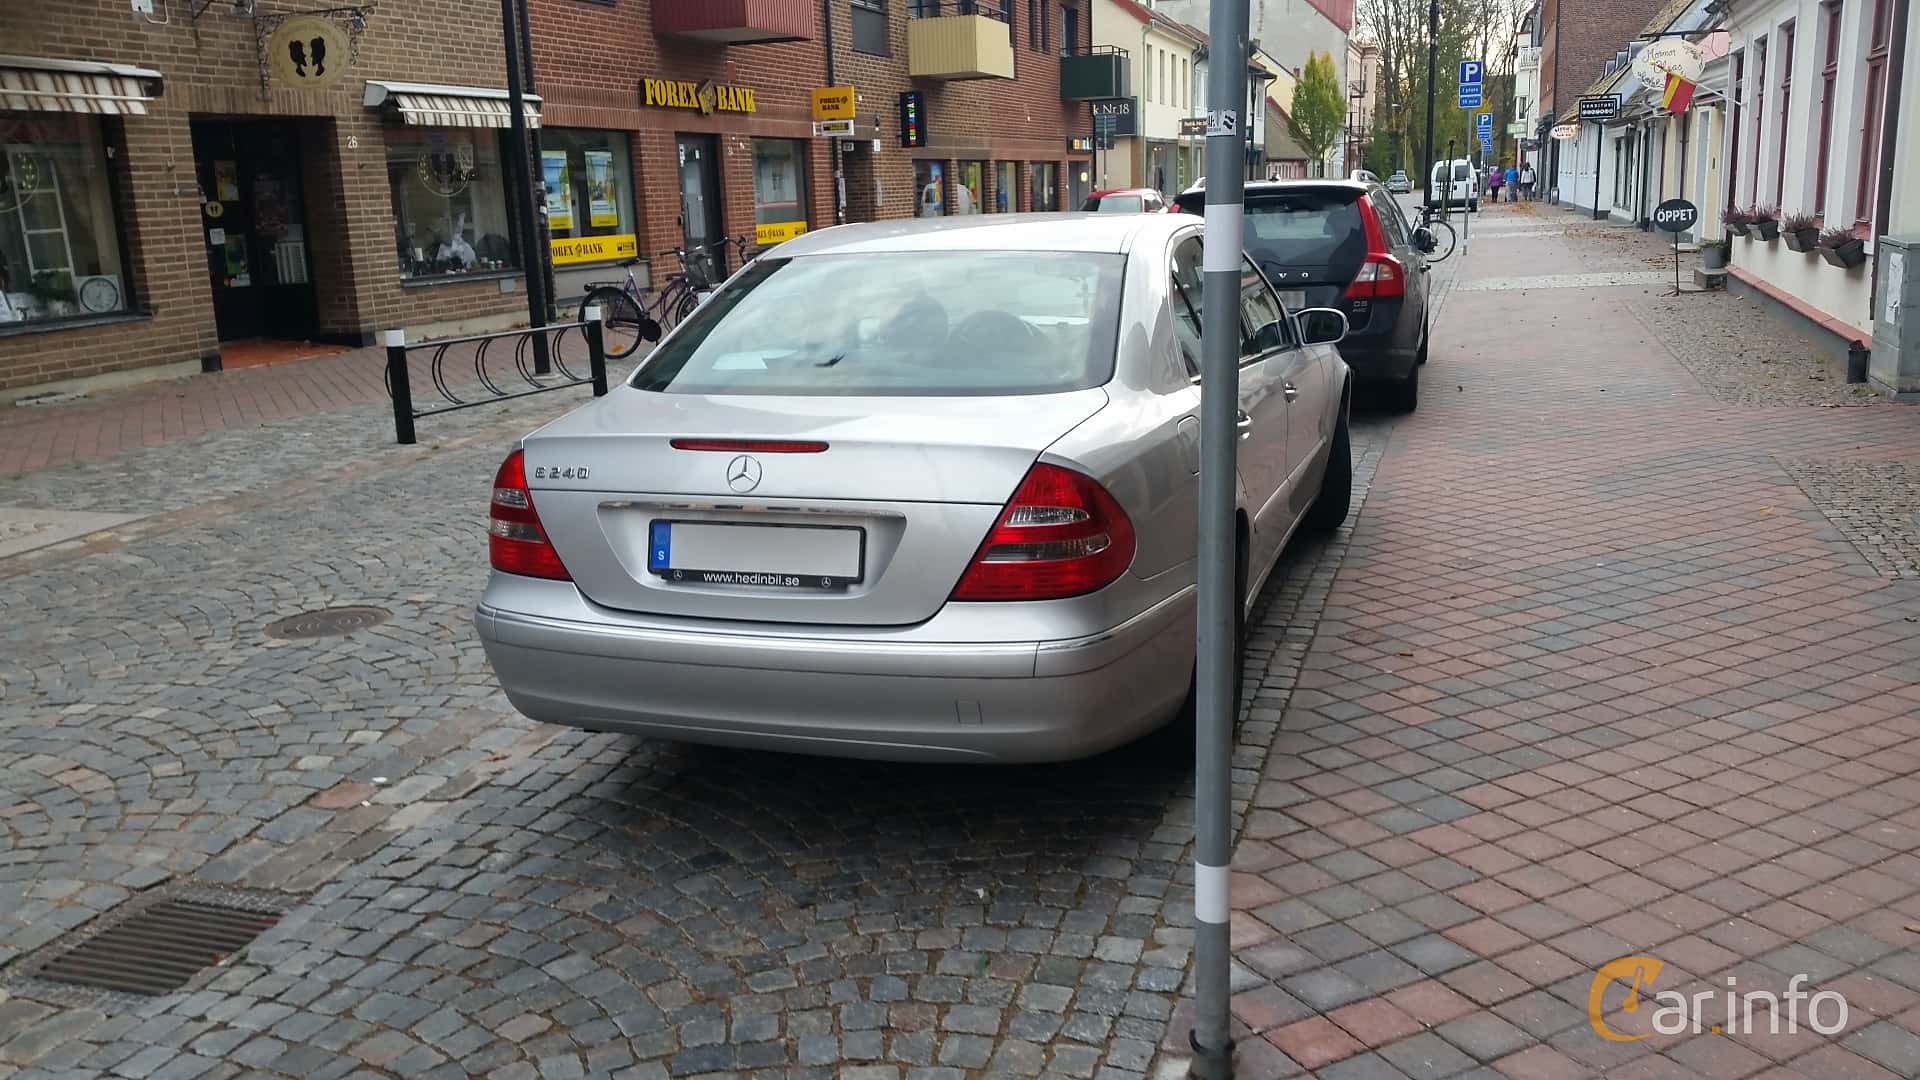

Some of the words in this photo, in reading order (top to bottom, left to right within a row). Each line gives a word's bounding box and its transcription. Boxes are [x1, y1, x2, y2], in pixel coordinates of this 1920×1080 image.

[1465, 63, 1479, 82] P
[643, 78, 699, 109] FOREX
[716, 85, 756, 113] BANK
[819, 96, 841, 104] FOREX
[1481, 115, 1489, 125] P
[346, 136, 359, 149] 26
[1657, 208, 1694, 222] ÖPPET
[535, 466, 546, 478] E
[549, 466, 590, 479] 240
[657, 550, 665, 560] S
[703, 572, 800, 586] www.hedinbil.se
